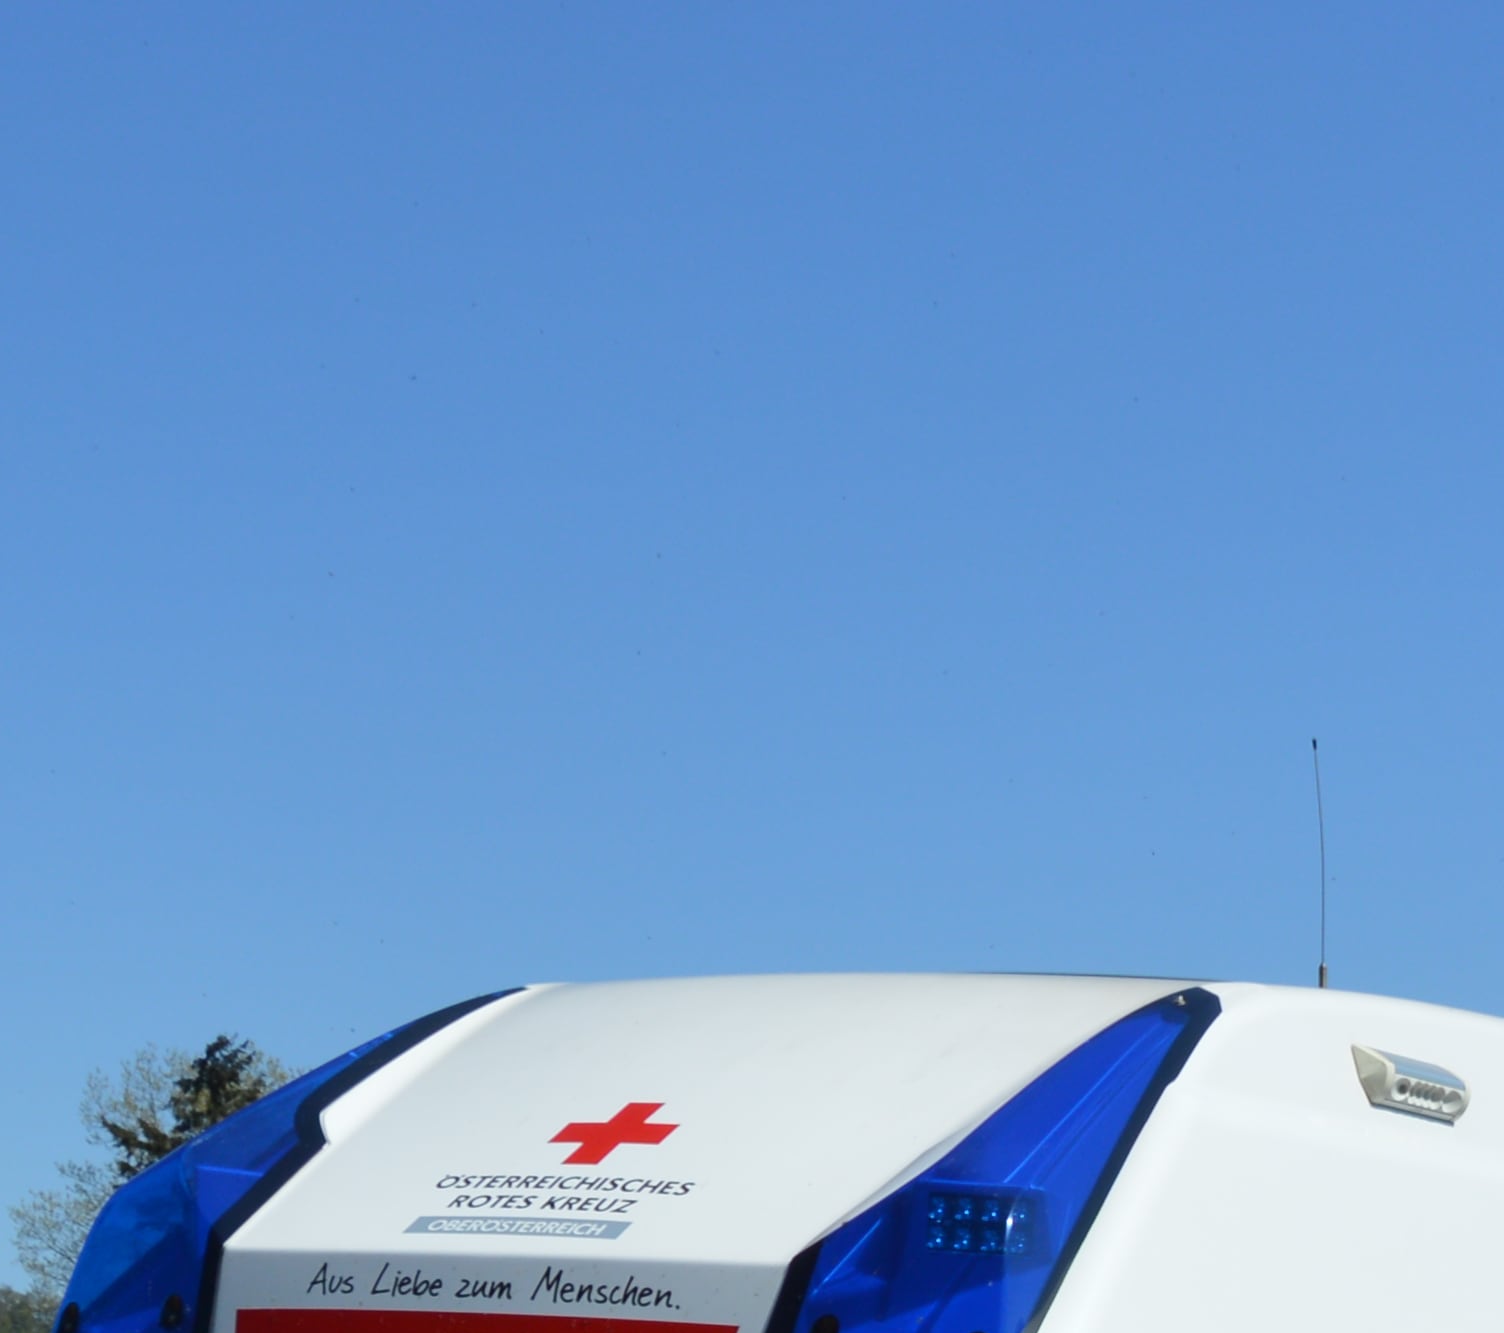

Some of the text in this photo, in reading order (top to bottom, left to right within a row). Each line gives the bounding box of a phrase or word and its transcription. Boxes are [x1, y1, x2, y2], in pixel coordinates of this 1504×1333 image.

[435, 1174, 696, 1196] ÖSTERREICHISCHES
[447, 1195, 638, 1213] ROTES KREUZ
[427, 1218, 608, 1237] OBERÖSTERREICH
[307, 1262, 681, 1310] Aus Liebe zum Menschen.
